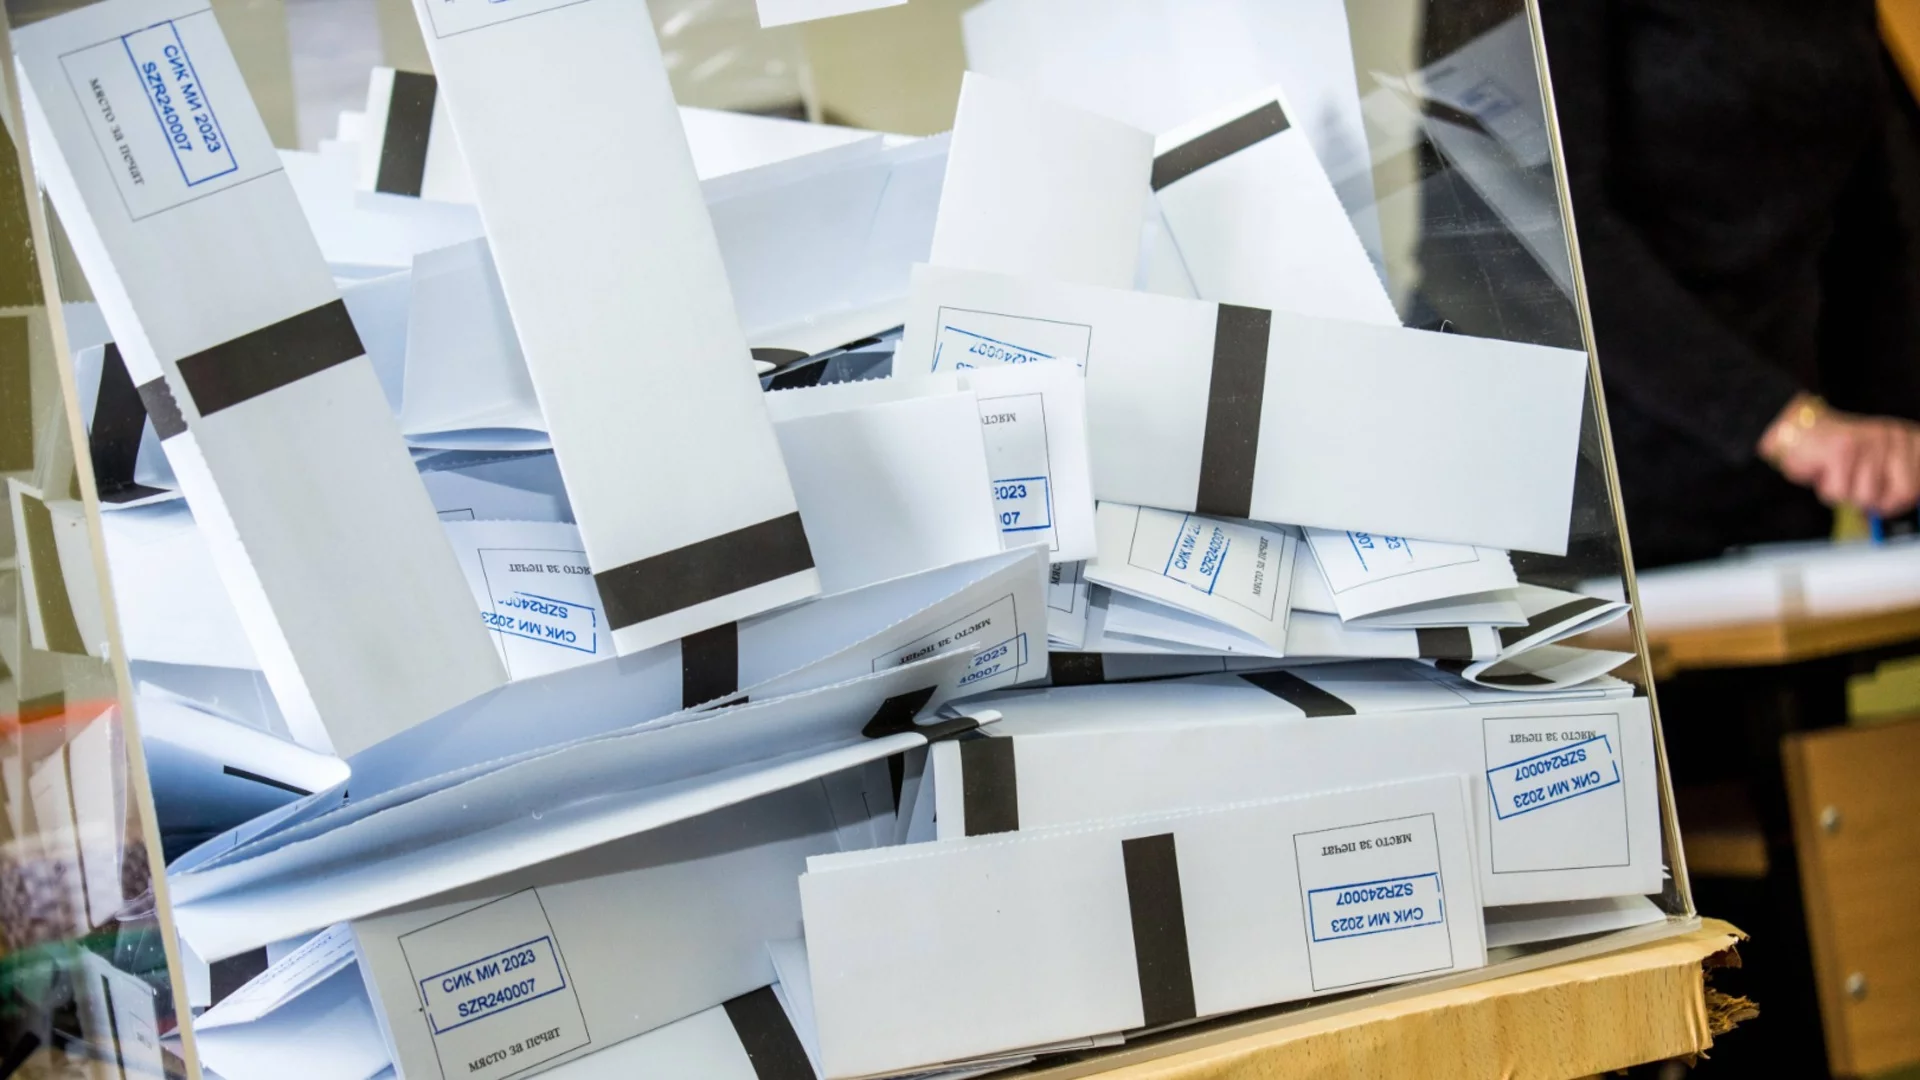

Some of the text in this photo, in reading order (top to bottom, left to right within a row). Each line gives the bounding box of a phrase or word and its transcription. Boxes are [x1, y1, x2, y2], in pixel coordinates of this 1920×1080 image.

[142, 61, 193, 152] SZR240007
[164, 45, 222, 153] СИК МИ 2023
[89, 77, 145, 186] място за печат
[982, 413, 1017, 425] мяст
[508, 563, 544, 573] печат
[546, 564, 561, 574] за
[1252, 536, 1269, 596] място за печат
[519, 620, 542, 635] МИ
[546, 625, 577, 643] СИК
[900, 618, 992, 664] място за печат
[974, 645, 1008, 667] 2023
[1508, 730, 1597, 744] място за печат
[1514, 748, 1587, 781] SZR240007
[1513, 770, 1601, 808] СИК МИ 2023
[1321, 833, 1412, 857] място за печат
[1336, 882, 1414, 906] SZR240007
[1330, 907, 1424, 933] СИК МИ 2023
[442, 949, 536, 993] СИК МИ 2023
[458, 978, 536, 1018] SZR240007
[468, 1026, 561, 1073] място за печат
